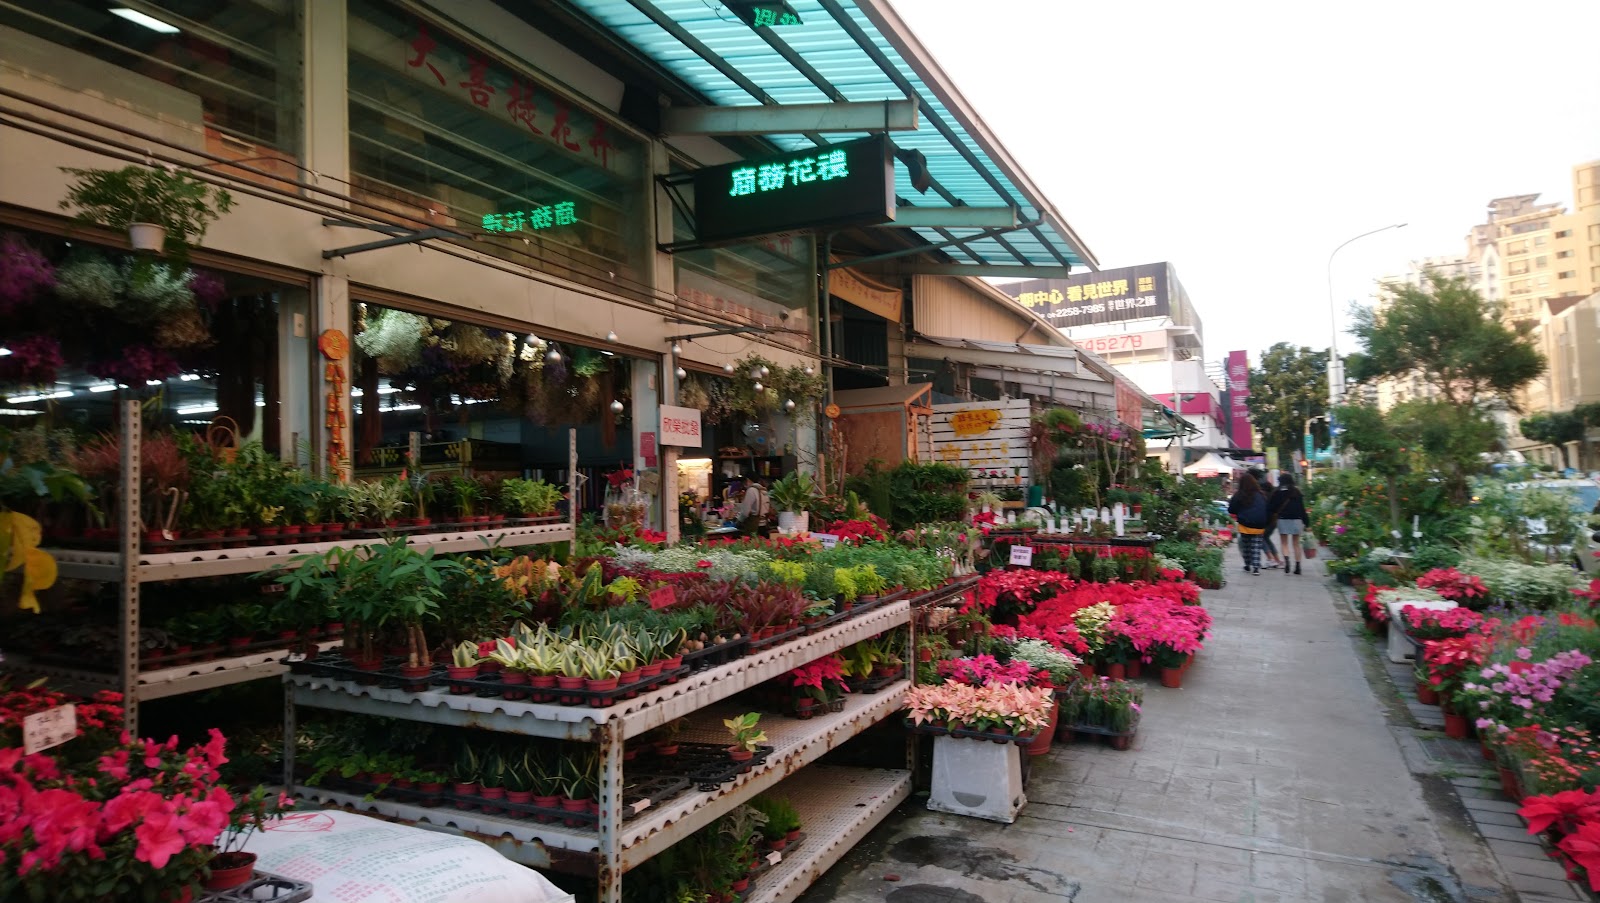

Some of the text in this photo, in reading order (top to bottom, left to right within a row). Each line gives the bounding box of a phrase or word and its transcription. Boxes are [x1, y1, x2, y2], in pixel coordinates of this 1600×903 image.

[729, 149, 849, 197] 商務花禮
[1067, 279, 1129, 302] 看見世界
